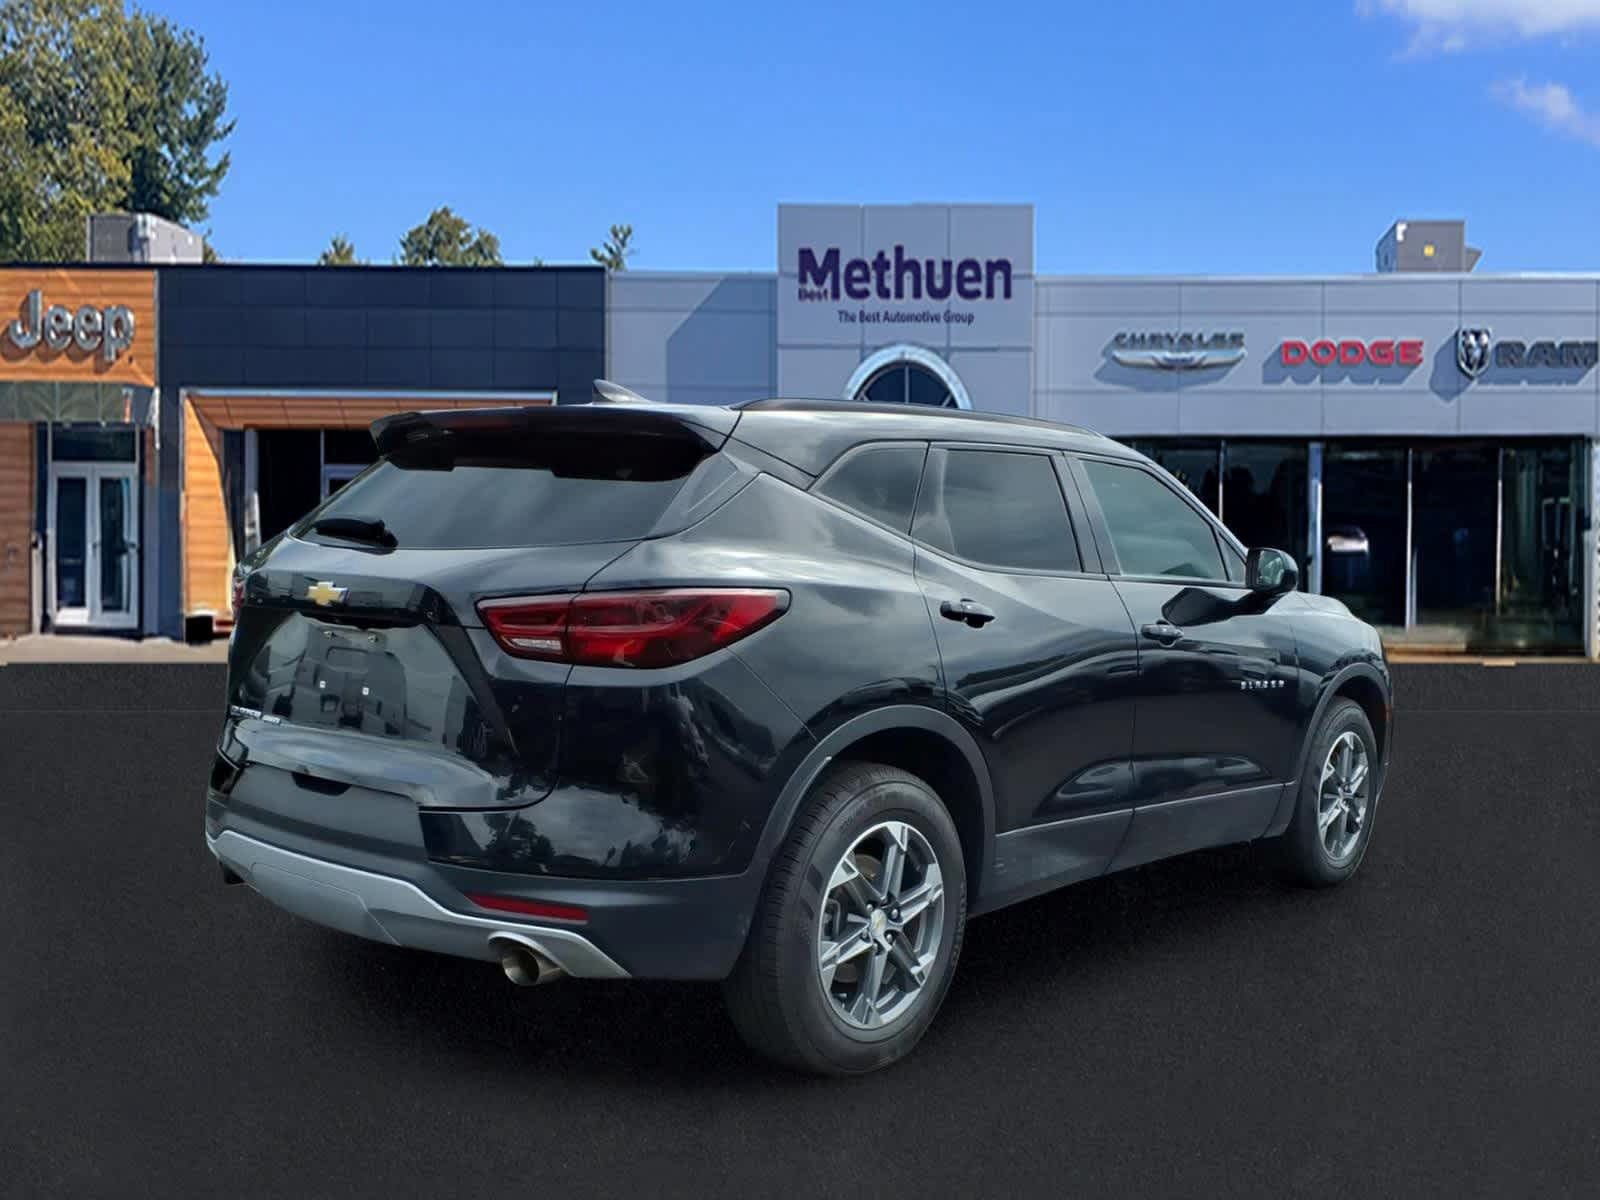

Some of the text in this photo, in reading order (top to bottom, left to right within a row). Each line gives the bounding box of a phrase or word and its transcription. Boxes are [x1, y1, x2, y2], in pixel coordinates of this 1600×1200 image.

[798, 245, 1012, 300] Methuen
[9, 288, 135, 362] Jeep
[838, 310, 975, 326] The Best Automotive Group
[1114, 332, 1245, 347] CHRYSLER
[1281, 340, 1424, 366] DODGE
[1495, 341, 1599, 369] RAM
